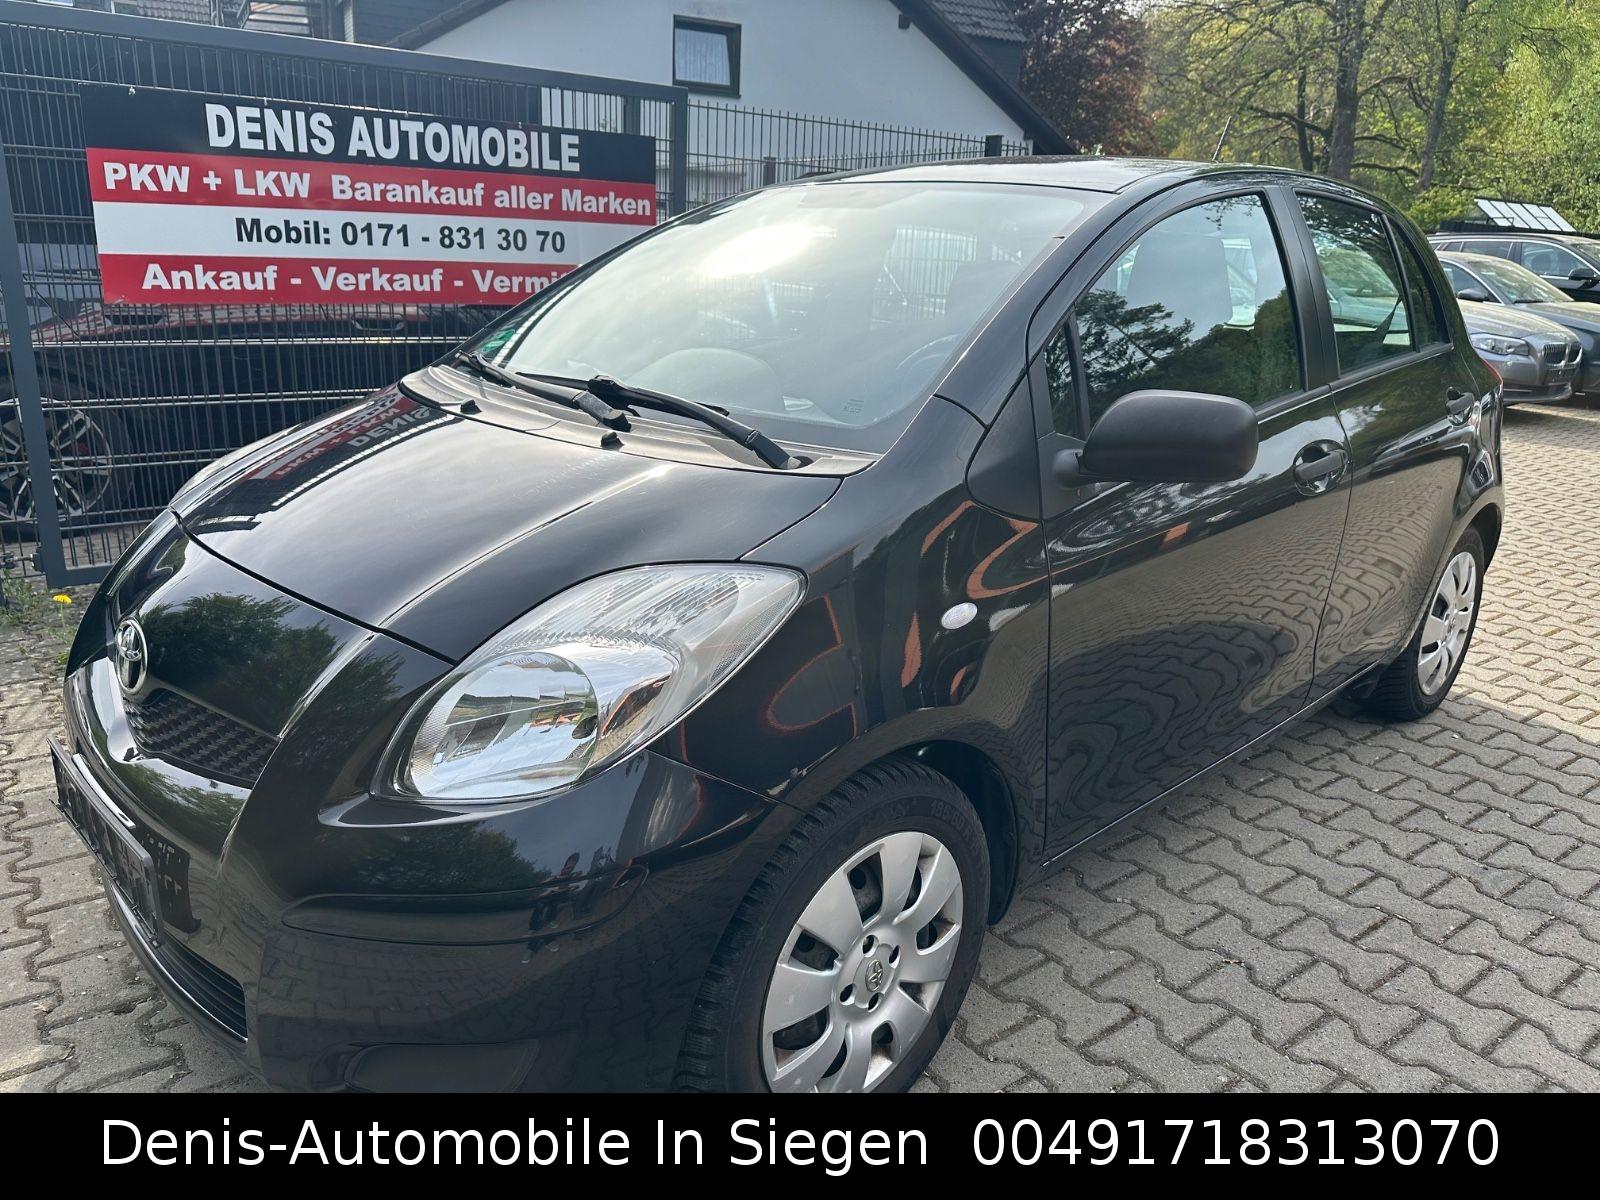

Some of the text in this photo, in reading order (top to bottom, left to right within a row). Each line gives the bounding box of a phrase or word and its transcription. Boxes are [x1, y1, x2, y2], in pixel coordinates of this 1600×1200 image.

[205, 103, 580, 173] DENIS AUTOMOBILE
[103, 161, 651, 217] PKW + LKW Barankauf aller Marken
[235, 217, 566, 254] Mobil: 0171 - 831 30 70
[141, 263, 568, 294] Ankauf - Verkauf - Vermi
